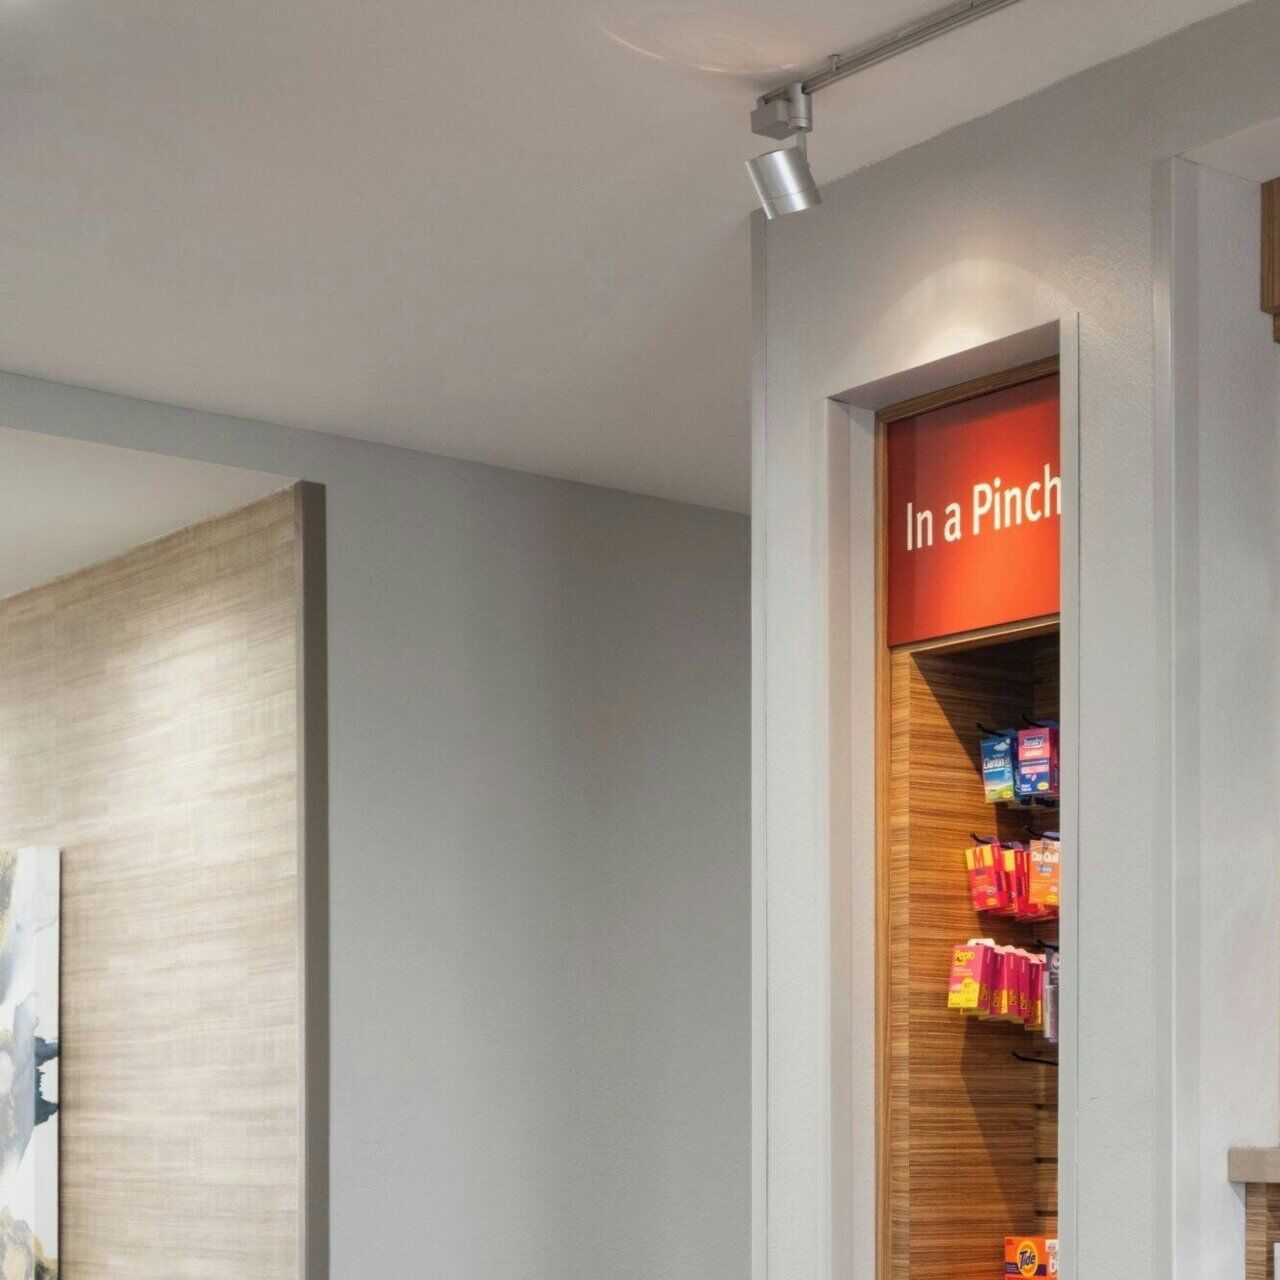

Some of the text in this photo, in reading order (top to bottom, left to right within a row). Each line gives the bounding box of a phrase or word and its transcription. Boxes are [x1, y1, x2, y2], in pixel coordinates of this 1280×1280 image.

[906, 463, 1061, 551] In a Pinch
[1019, 1249, 1036, 1270] Tide
